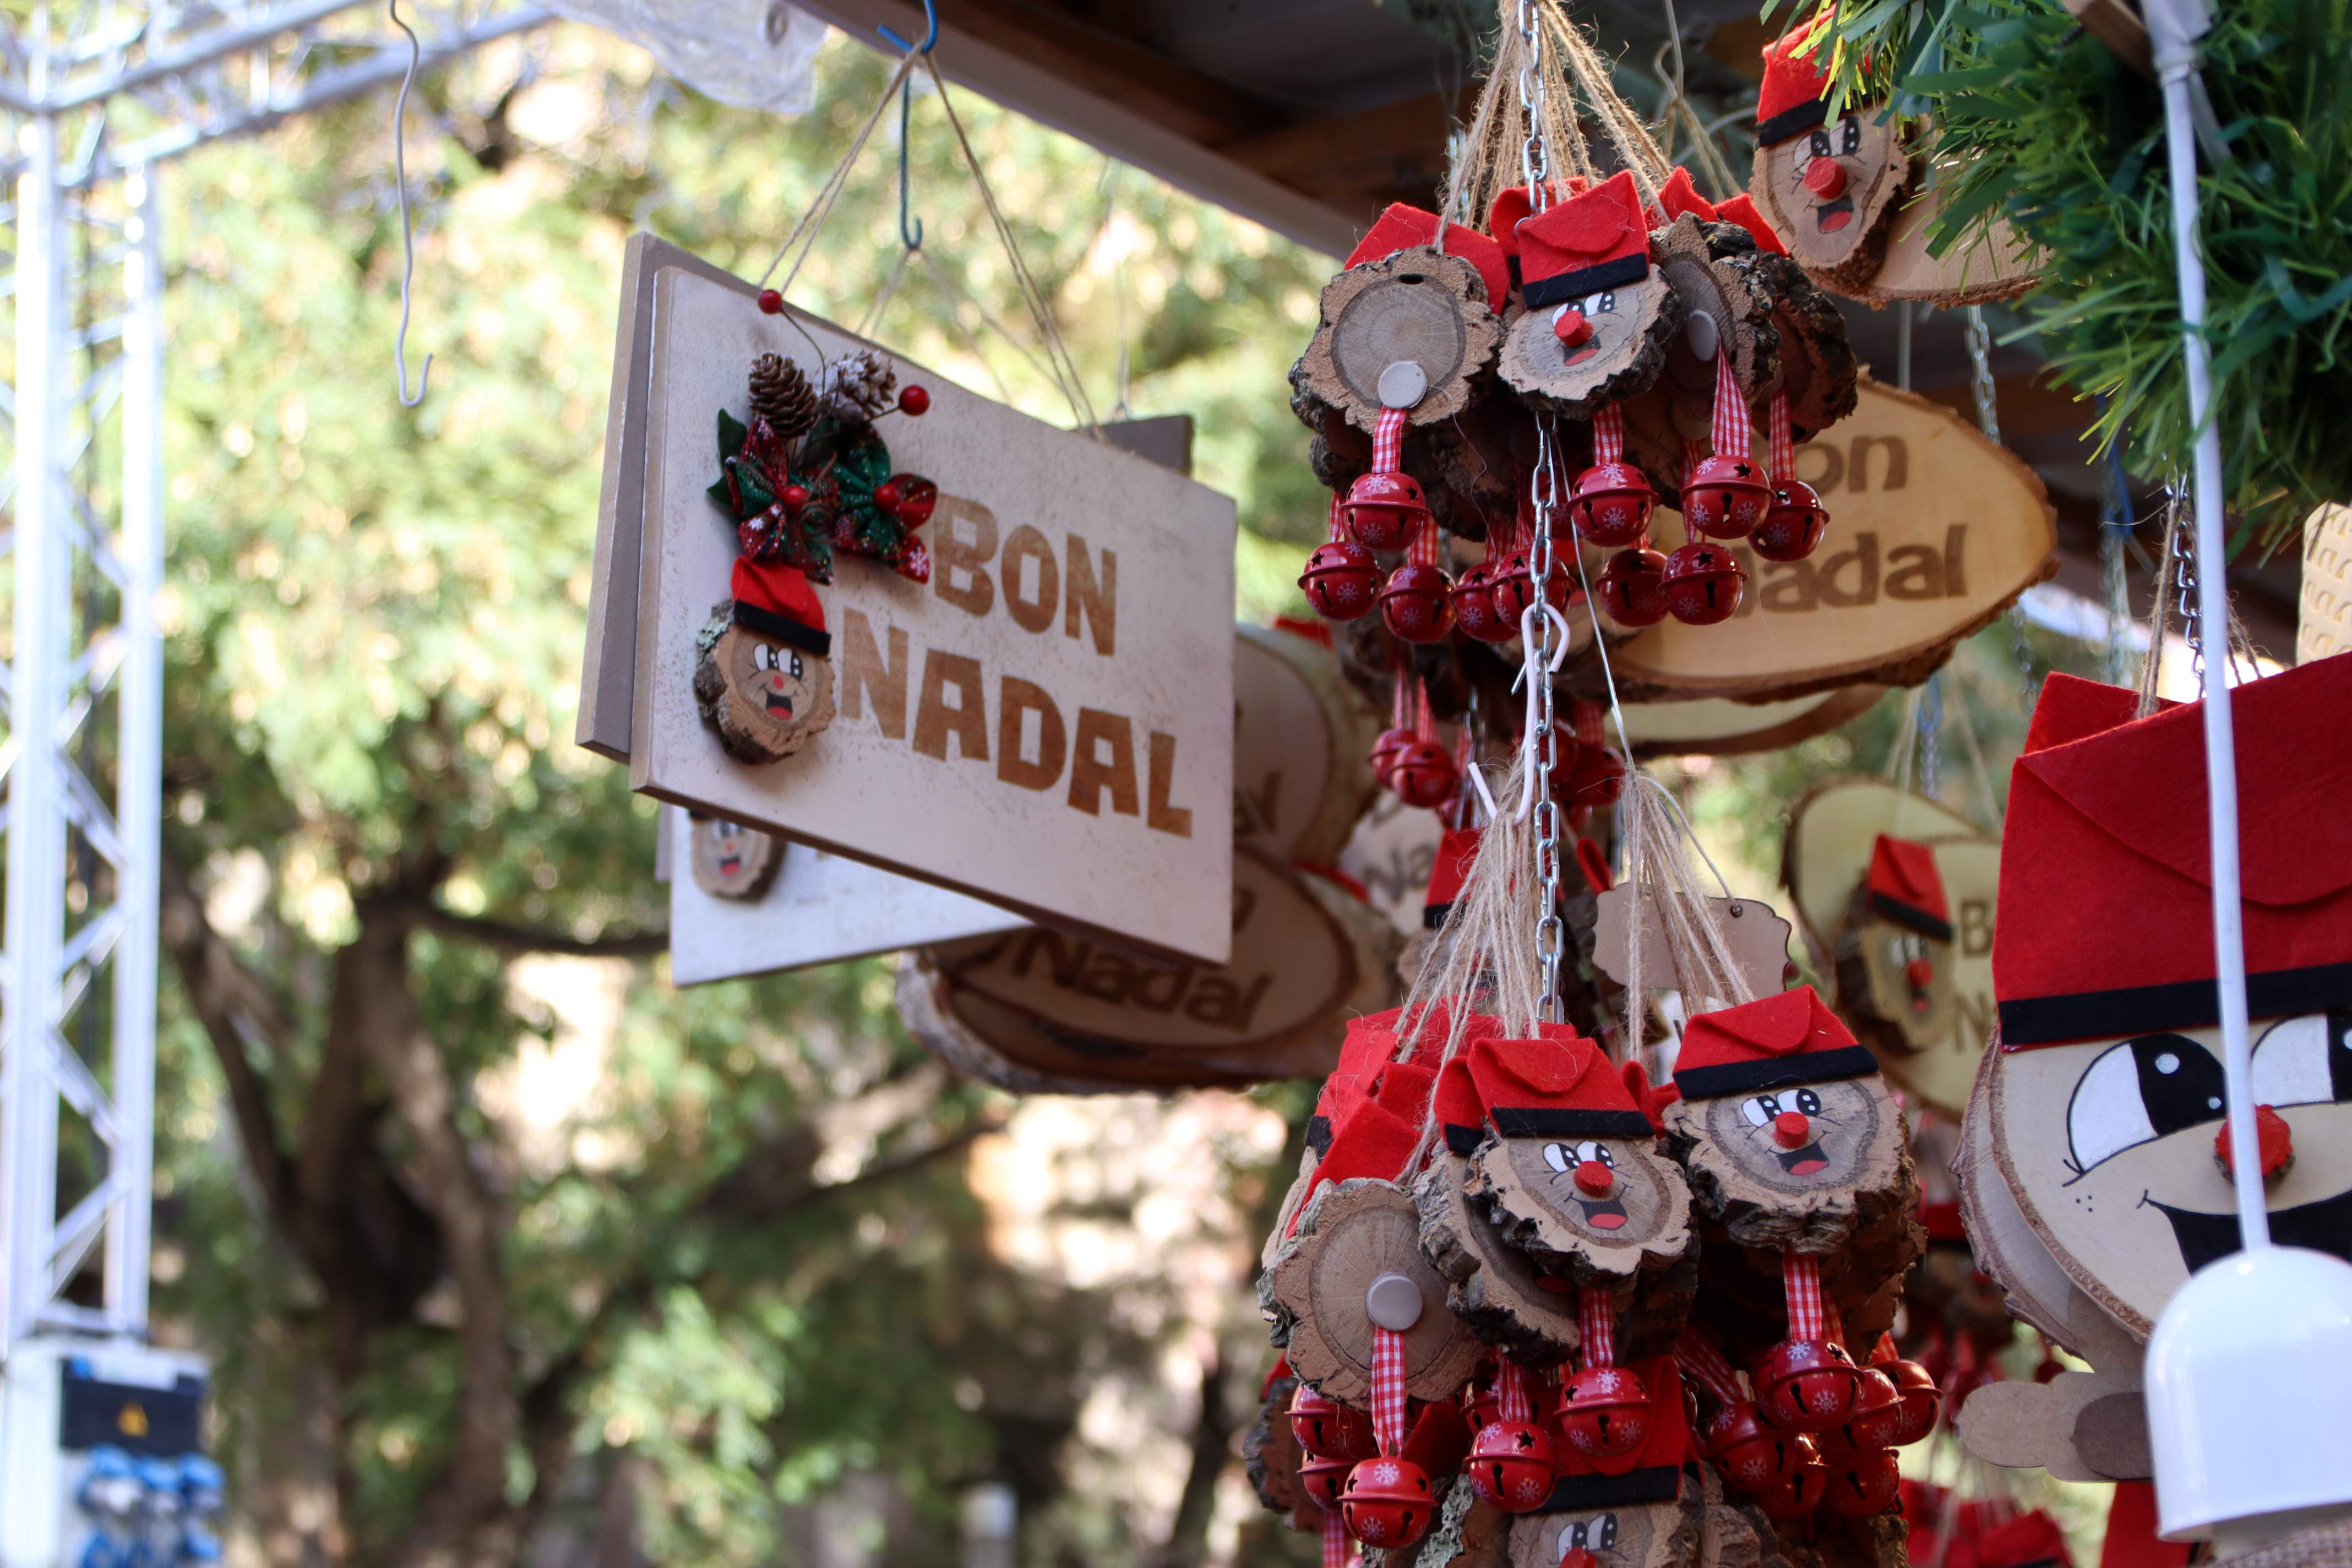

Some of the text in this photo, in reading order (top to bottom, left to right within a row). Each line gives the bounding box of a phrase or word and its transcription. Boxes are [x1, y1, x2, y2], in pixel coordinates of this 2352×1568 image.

[1788, 434, 1909, 494] on
[933, 494, 1117, 656] BON
[840, 606, 1193, 839] NADAL
[1011, 926, 1273, 1032] Nadal
